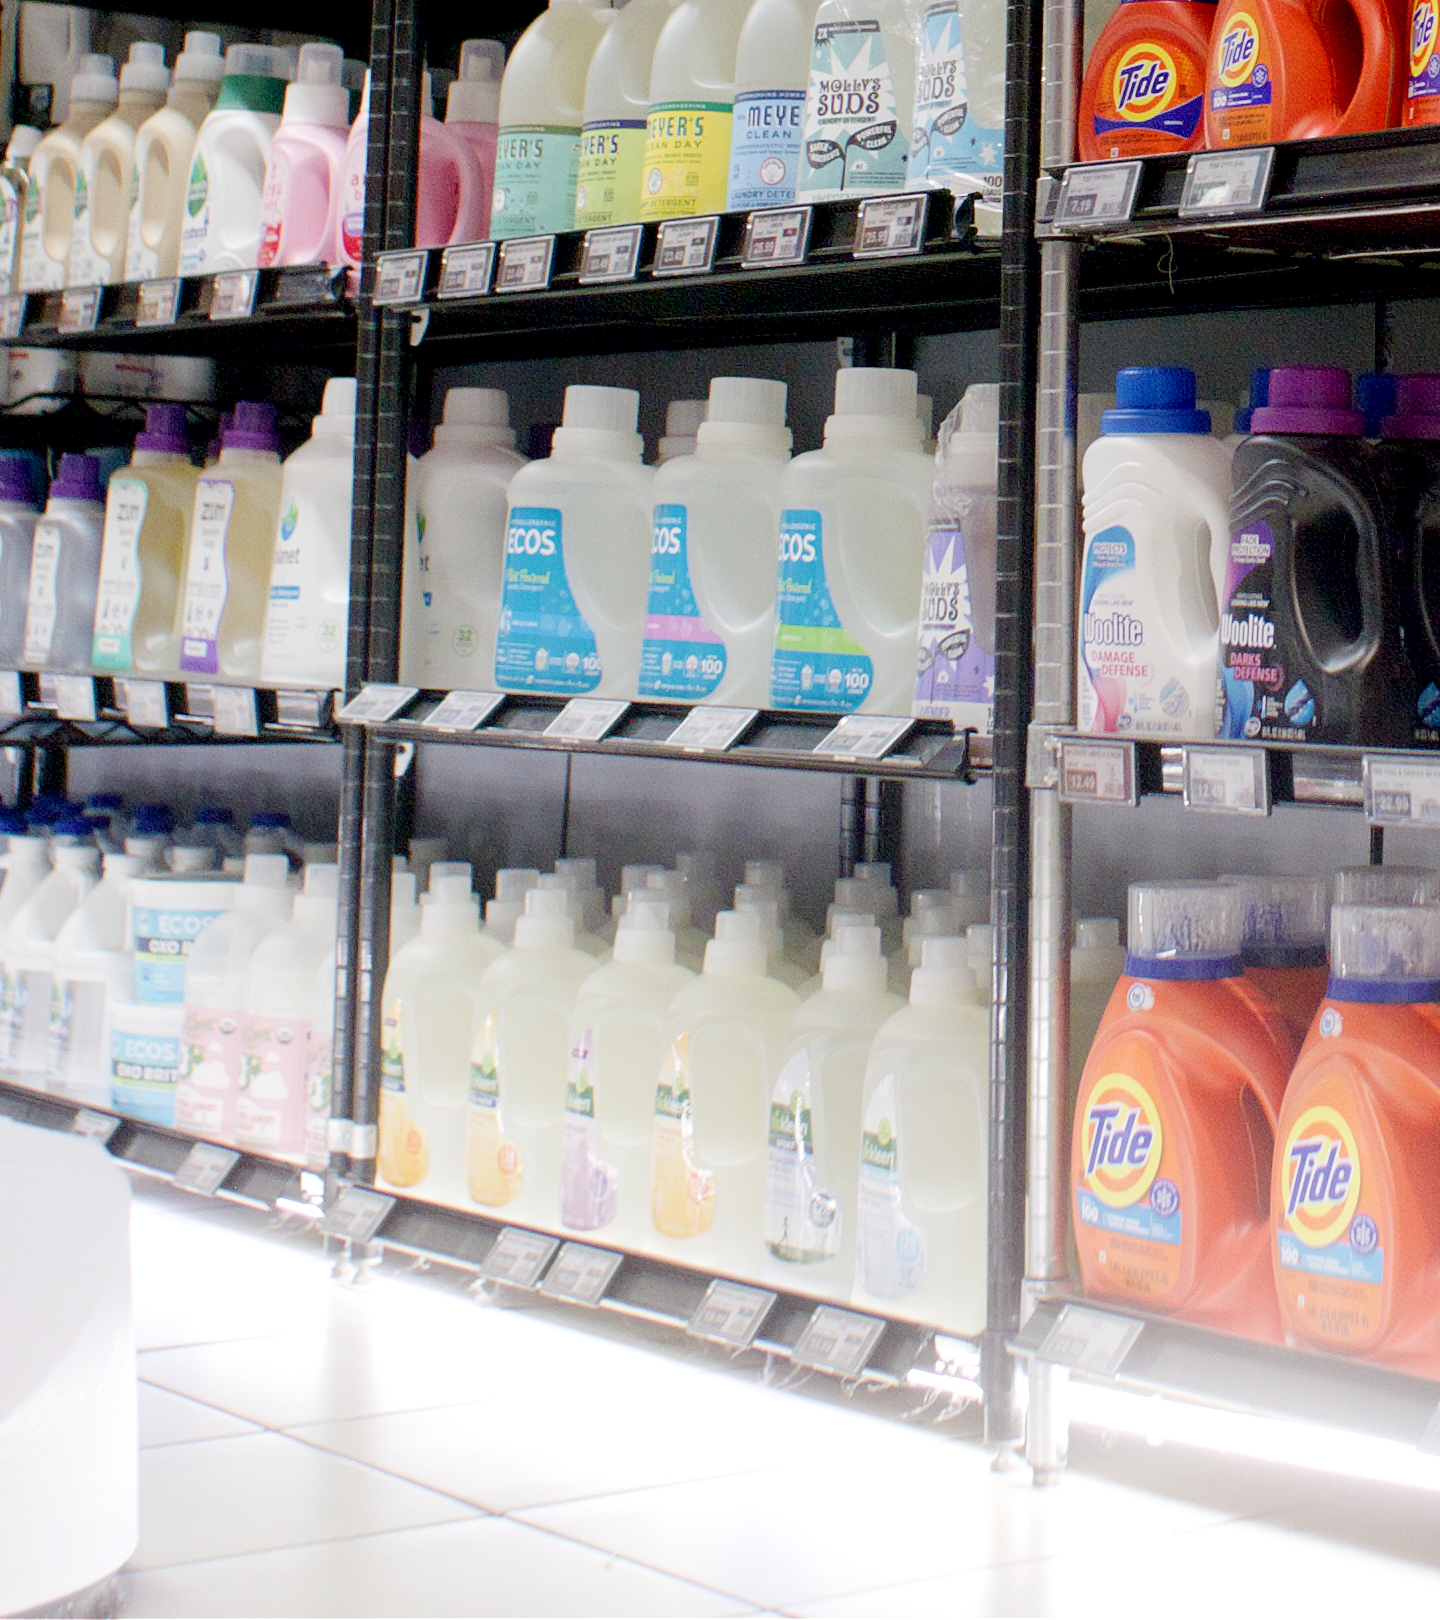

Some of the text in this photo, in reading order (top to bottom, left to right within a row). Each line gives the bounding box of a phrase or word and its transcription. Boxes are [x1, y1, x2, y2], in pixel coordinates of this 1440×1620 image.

[1220, 26, 1255, 78] Tide
[819, 77, 882, 94] MOLLY'S
[1115, 60, 1171, 113] Tide
[817, 92, 881, 117] SUDS
[745, 130, 793, 141] CLEAN
[864, 137, 888, 151] CLEAN
[673, 139, 703, 150] DAY
[983, 175, 1003, 188] 100
[506, 528, 556, 556] ECOS
[1093, 542, 1127, 554] PROTECTS
[1241, 534, 1260, 545] FADE
[1232, 543, 1271, 557] PROTECTION
[1083, 611, 1145, 647] Woolite
[1220, 612, 1277, 650] Woolite
[1091, 650, 1136, 665] DAMAGE
[1229, 652, 1262, 667] DARKS
[700, 658, 723, 675] 100
[1101, 663, 1149, 678] DEFENSE
[1234, 665, 1279, 682] DEFENSE
[844, 672, 870, 689] 100
[123, 1039, 177, 1061] ECOS
[1086, 1104, 1154, 1179] Tide
[1286, 1138, 1353, 1221] Tide
